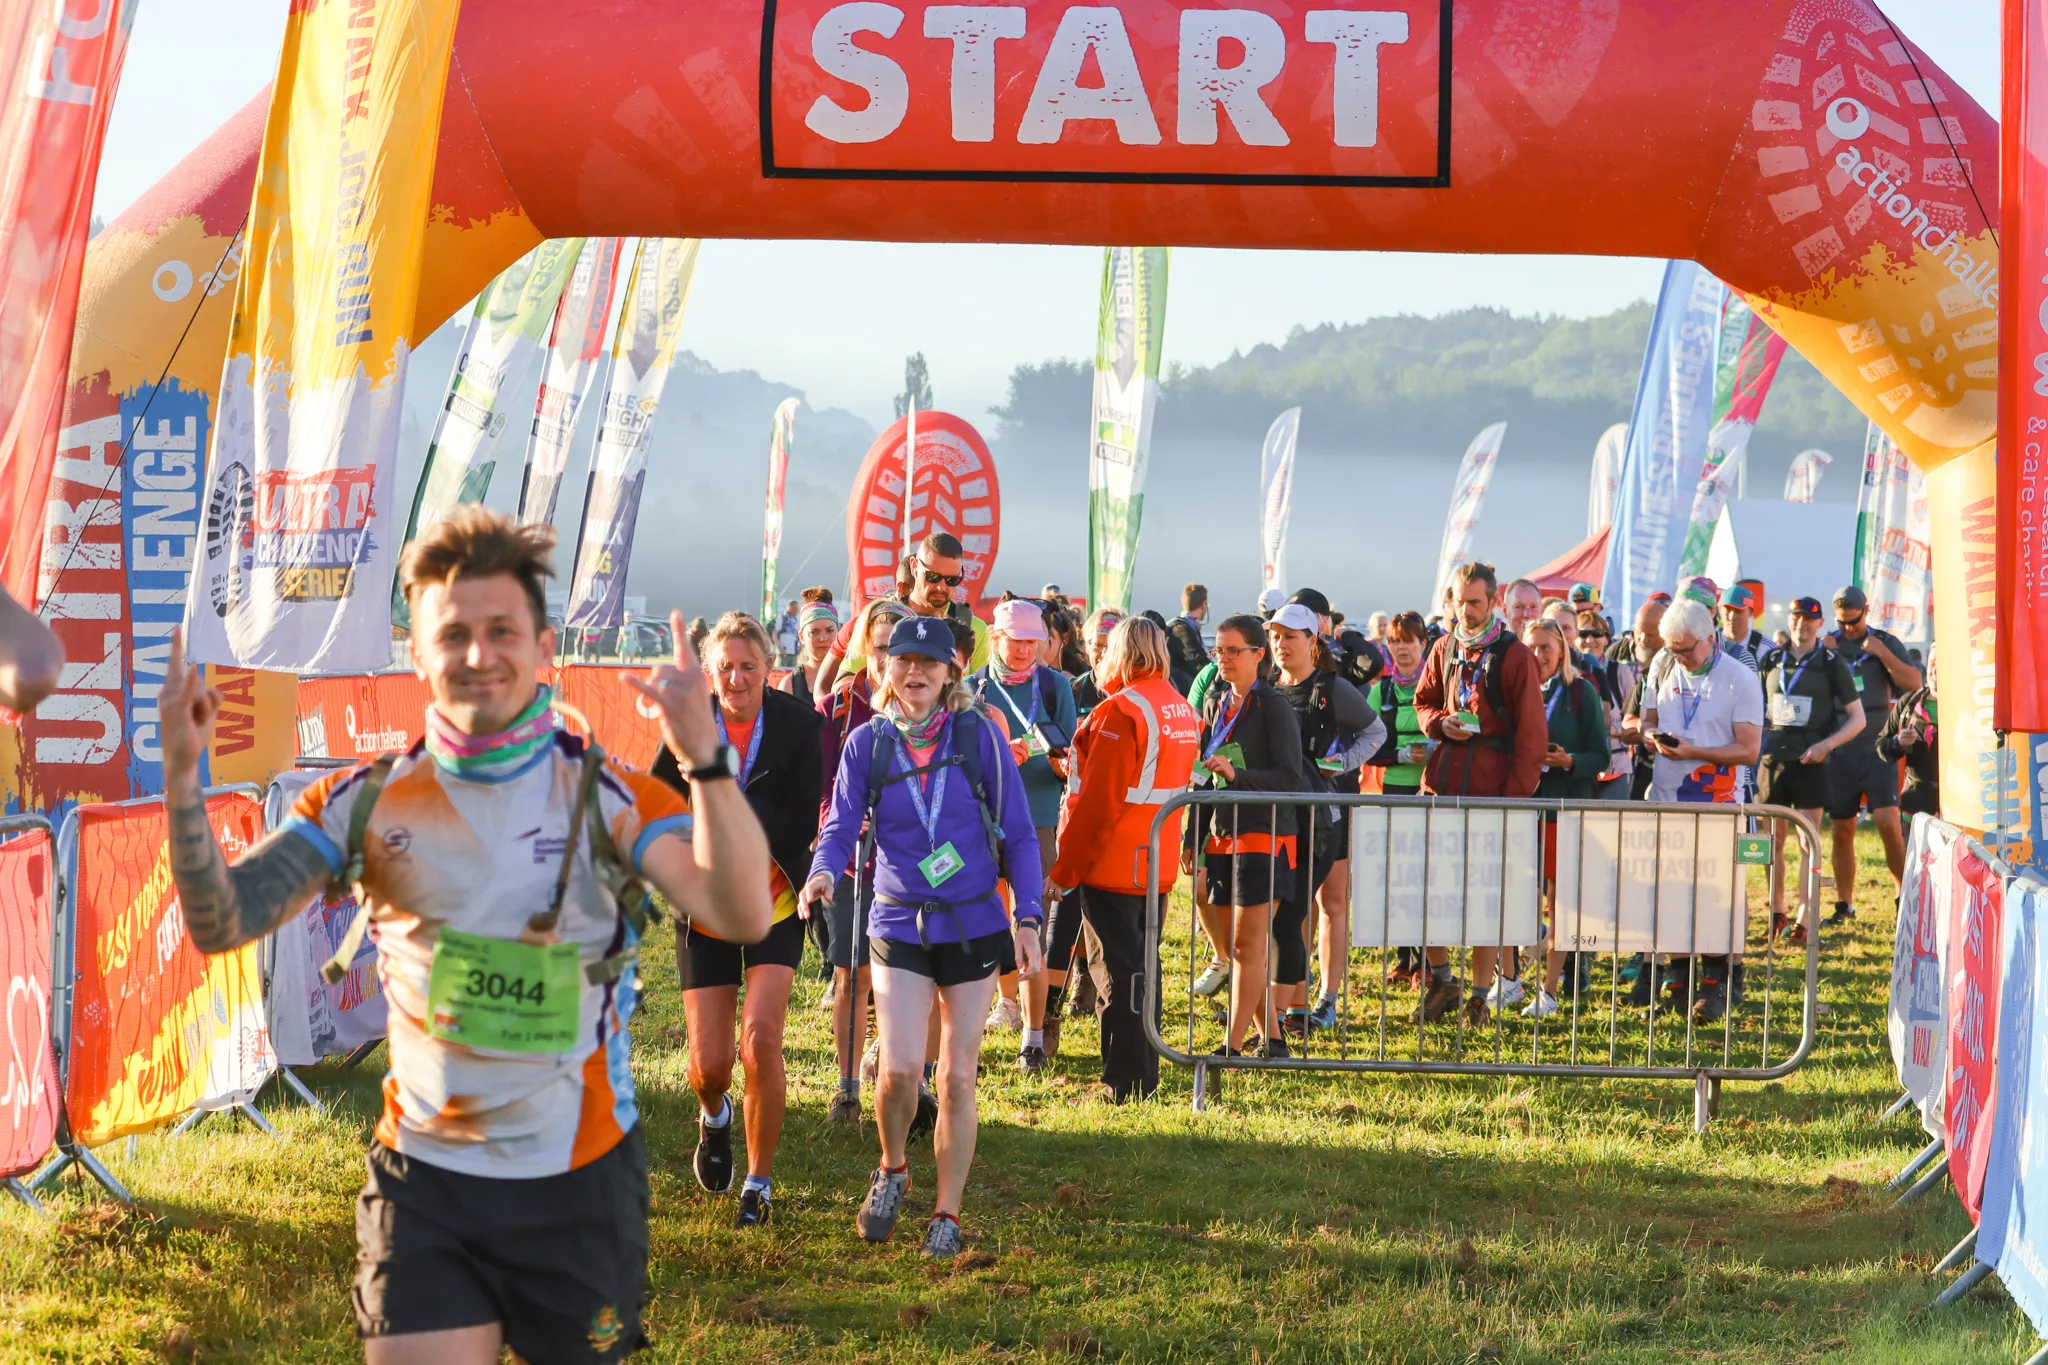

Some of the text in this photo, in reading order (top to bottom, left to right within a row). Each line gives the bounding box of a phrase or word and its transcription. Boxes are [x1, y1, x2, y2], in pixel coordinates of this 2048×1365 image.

[805, 2, 1409, 148] START
[1834, 146, 2000, 312] actionchalle
[257, 482, 371, 532] ULTRA
[2021, 441, 2041, 503] care
[256, 532, 364, 565] CHALLENG
[33, 414, 122, 764] ULTRA
[215, 664, 256, 758] WA
[466, 969, 546, 1007] 3044
